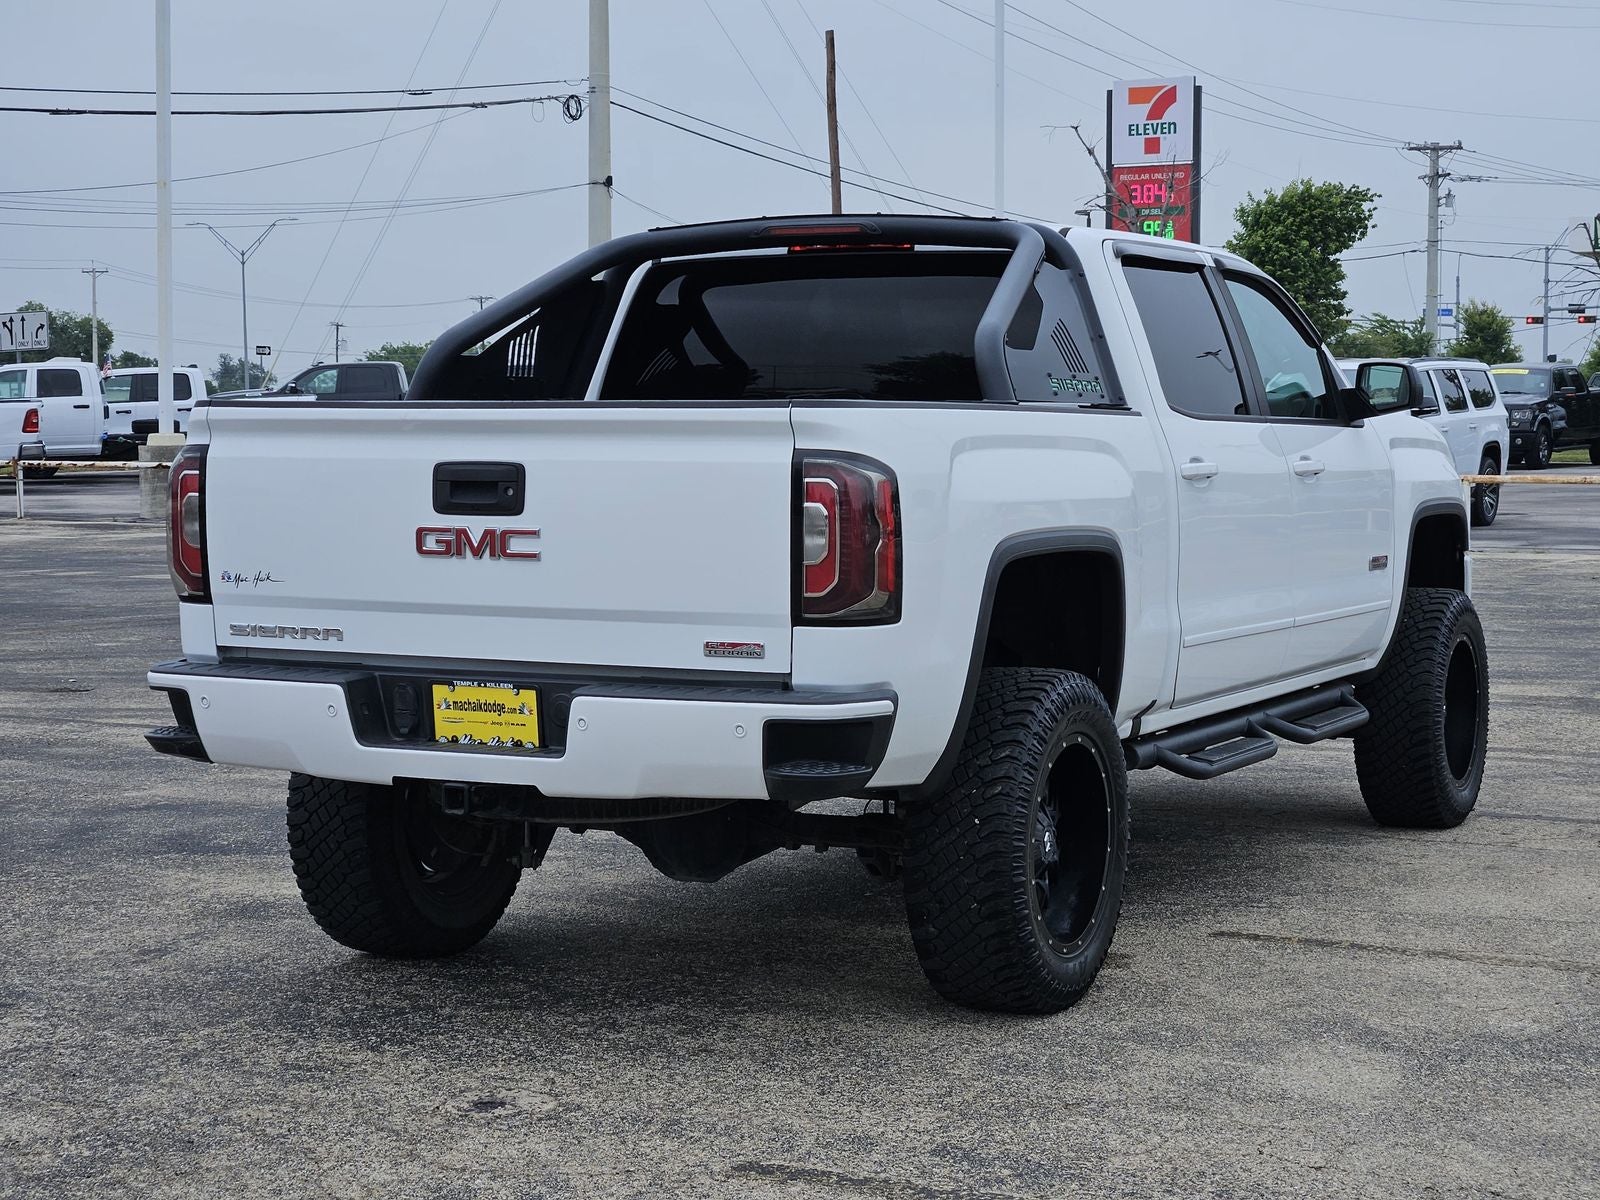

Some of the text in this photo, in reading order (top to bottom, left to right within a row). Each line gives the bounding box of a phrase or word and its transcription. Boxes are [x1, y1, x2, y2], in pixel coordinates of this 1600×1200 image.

[1128, 85, 1177, 155] 7
[1151, 172, 1185, 180] UNLEED
[1049, 377, 1104, 394] SIERRA
[415, 525, 542, 561] GMC
[229, 622, 344, 642] SIERRA
[452, 699, 517, 716] machaikdodge.com
